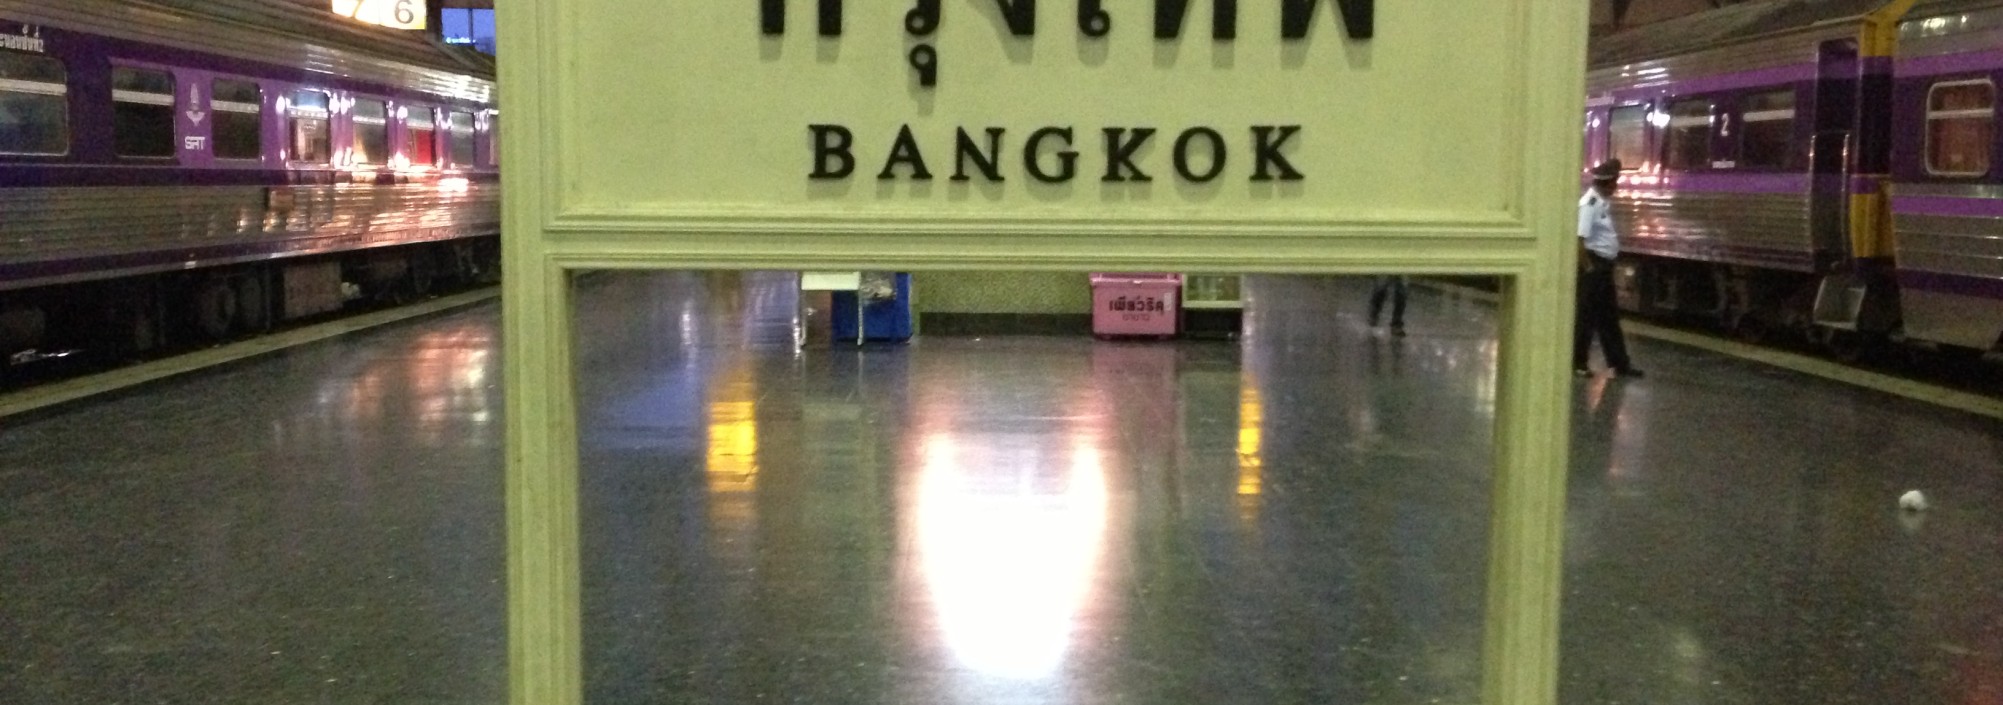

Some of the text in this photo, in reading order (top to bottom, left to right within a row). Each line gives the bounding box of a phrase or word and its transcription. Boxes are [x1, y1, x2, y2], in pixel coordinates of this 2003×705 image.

[394, 0, 414, 24] 6
[1720, 112, 1729, 137] 2
[808, 123, 1305, 183] BANGKOK
